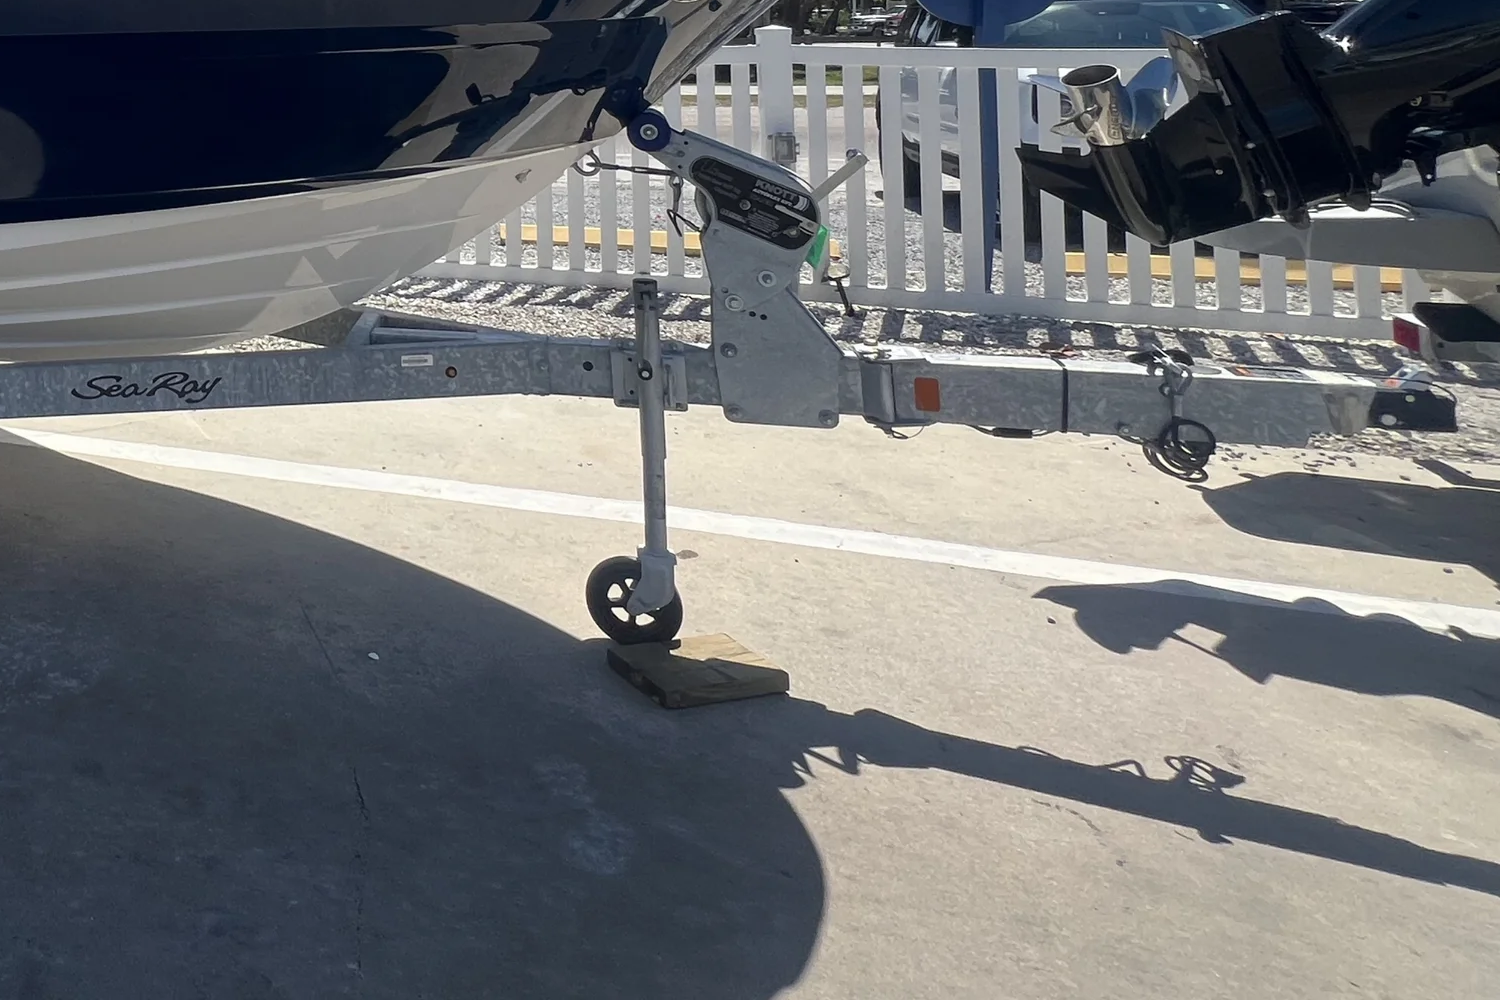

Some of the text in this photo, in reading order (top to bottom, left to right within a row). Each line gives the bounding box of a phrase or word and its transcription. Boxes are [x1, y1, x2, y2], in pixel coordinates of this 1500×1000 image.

[755, 179, 798, 201] KNOTT
[71, 371, 222, 404] Sea Ray
